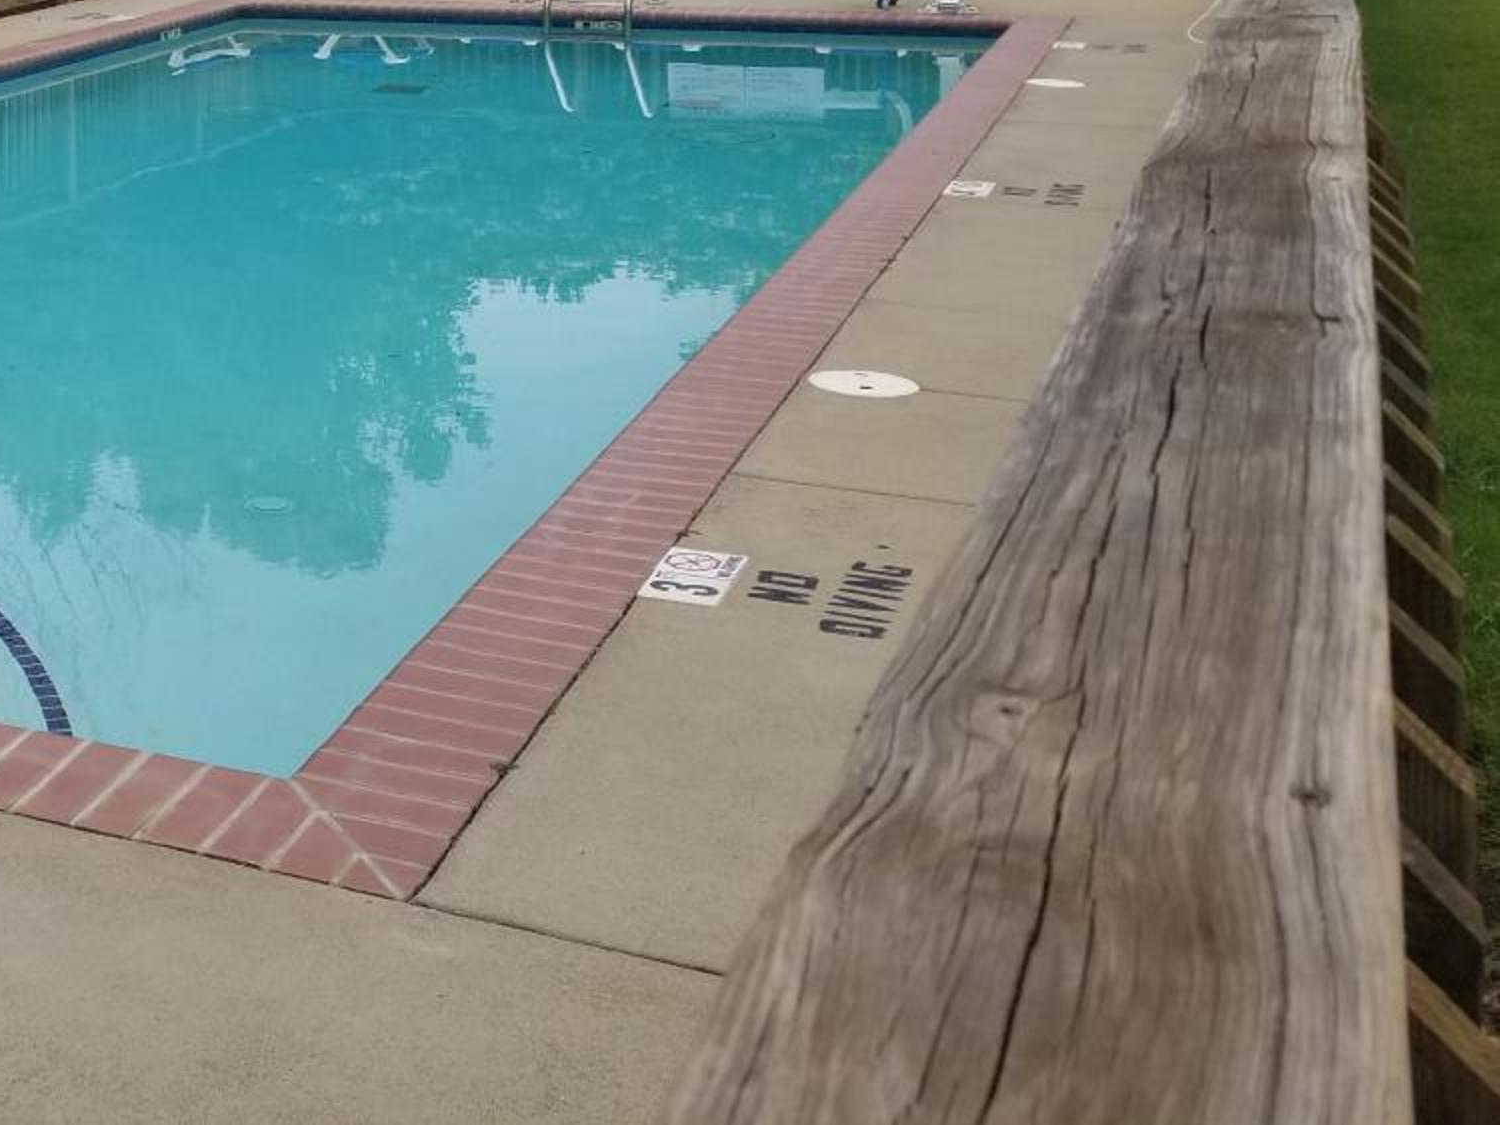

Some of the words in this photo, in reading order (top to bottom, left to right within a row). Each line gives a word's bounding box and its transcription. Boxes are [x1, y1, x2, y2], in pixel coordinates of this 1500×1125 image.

[647, 580, 720, 597] 3
[746, 570, 820, 606] NO
[819, 559, 914, 640] DIVING
